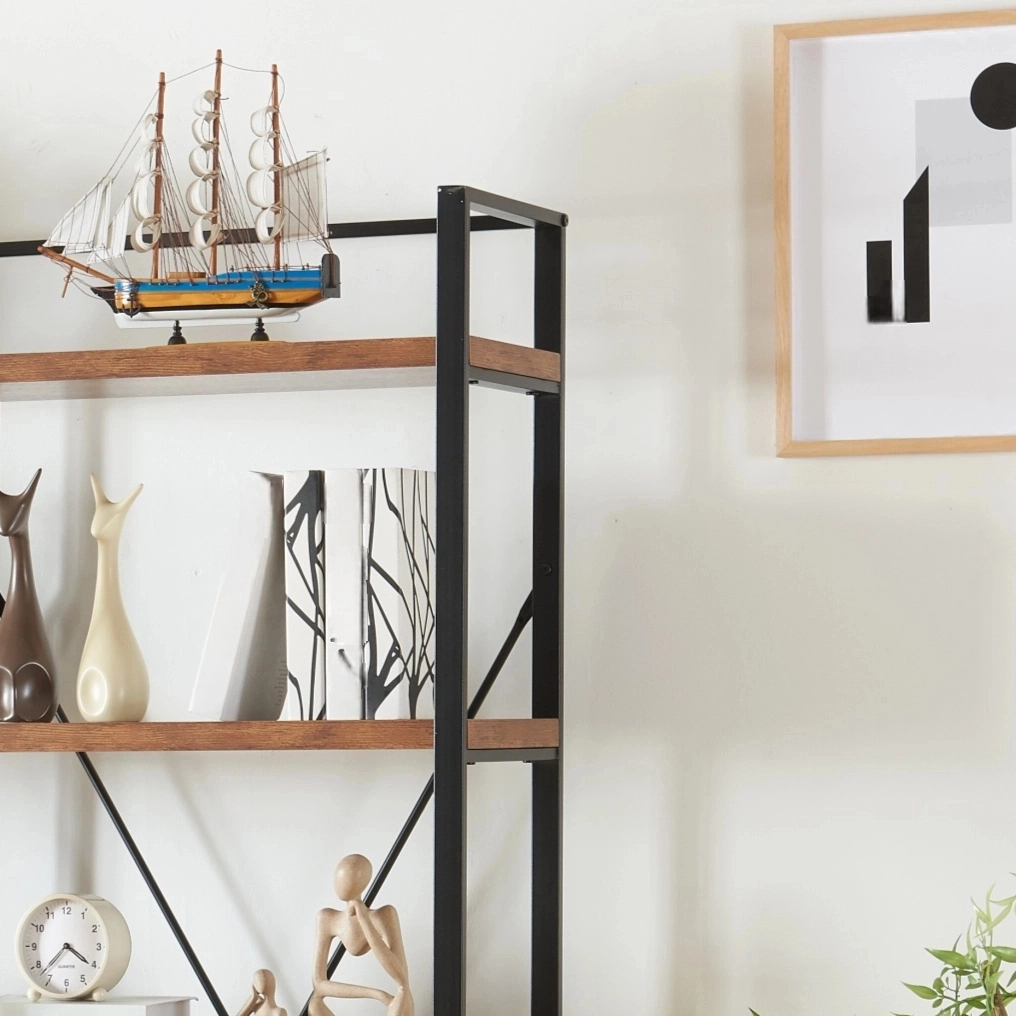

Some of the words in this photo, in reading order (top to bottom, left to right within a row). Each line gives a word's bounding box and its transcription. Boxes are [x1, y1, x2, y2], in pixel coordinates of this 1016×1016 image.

[62, 906, 71, 915] 12
[45, 911, 54, 919] 11
[81, 911, 85, 919] 1
[35, 924, 44, 932] 10
[92, 924, 97, 933] 2
[31, 942, 37, 951] 9
[96, 942, 101, 951] 3
[36, 960, 41, 969] 8
[91, 960, 96, 968] 4
[48, 974, 52, 982] 7
[80, 974, 85, 983] 5
[64, 979, 69, 987] 6
